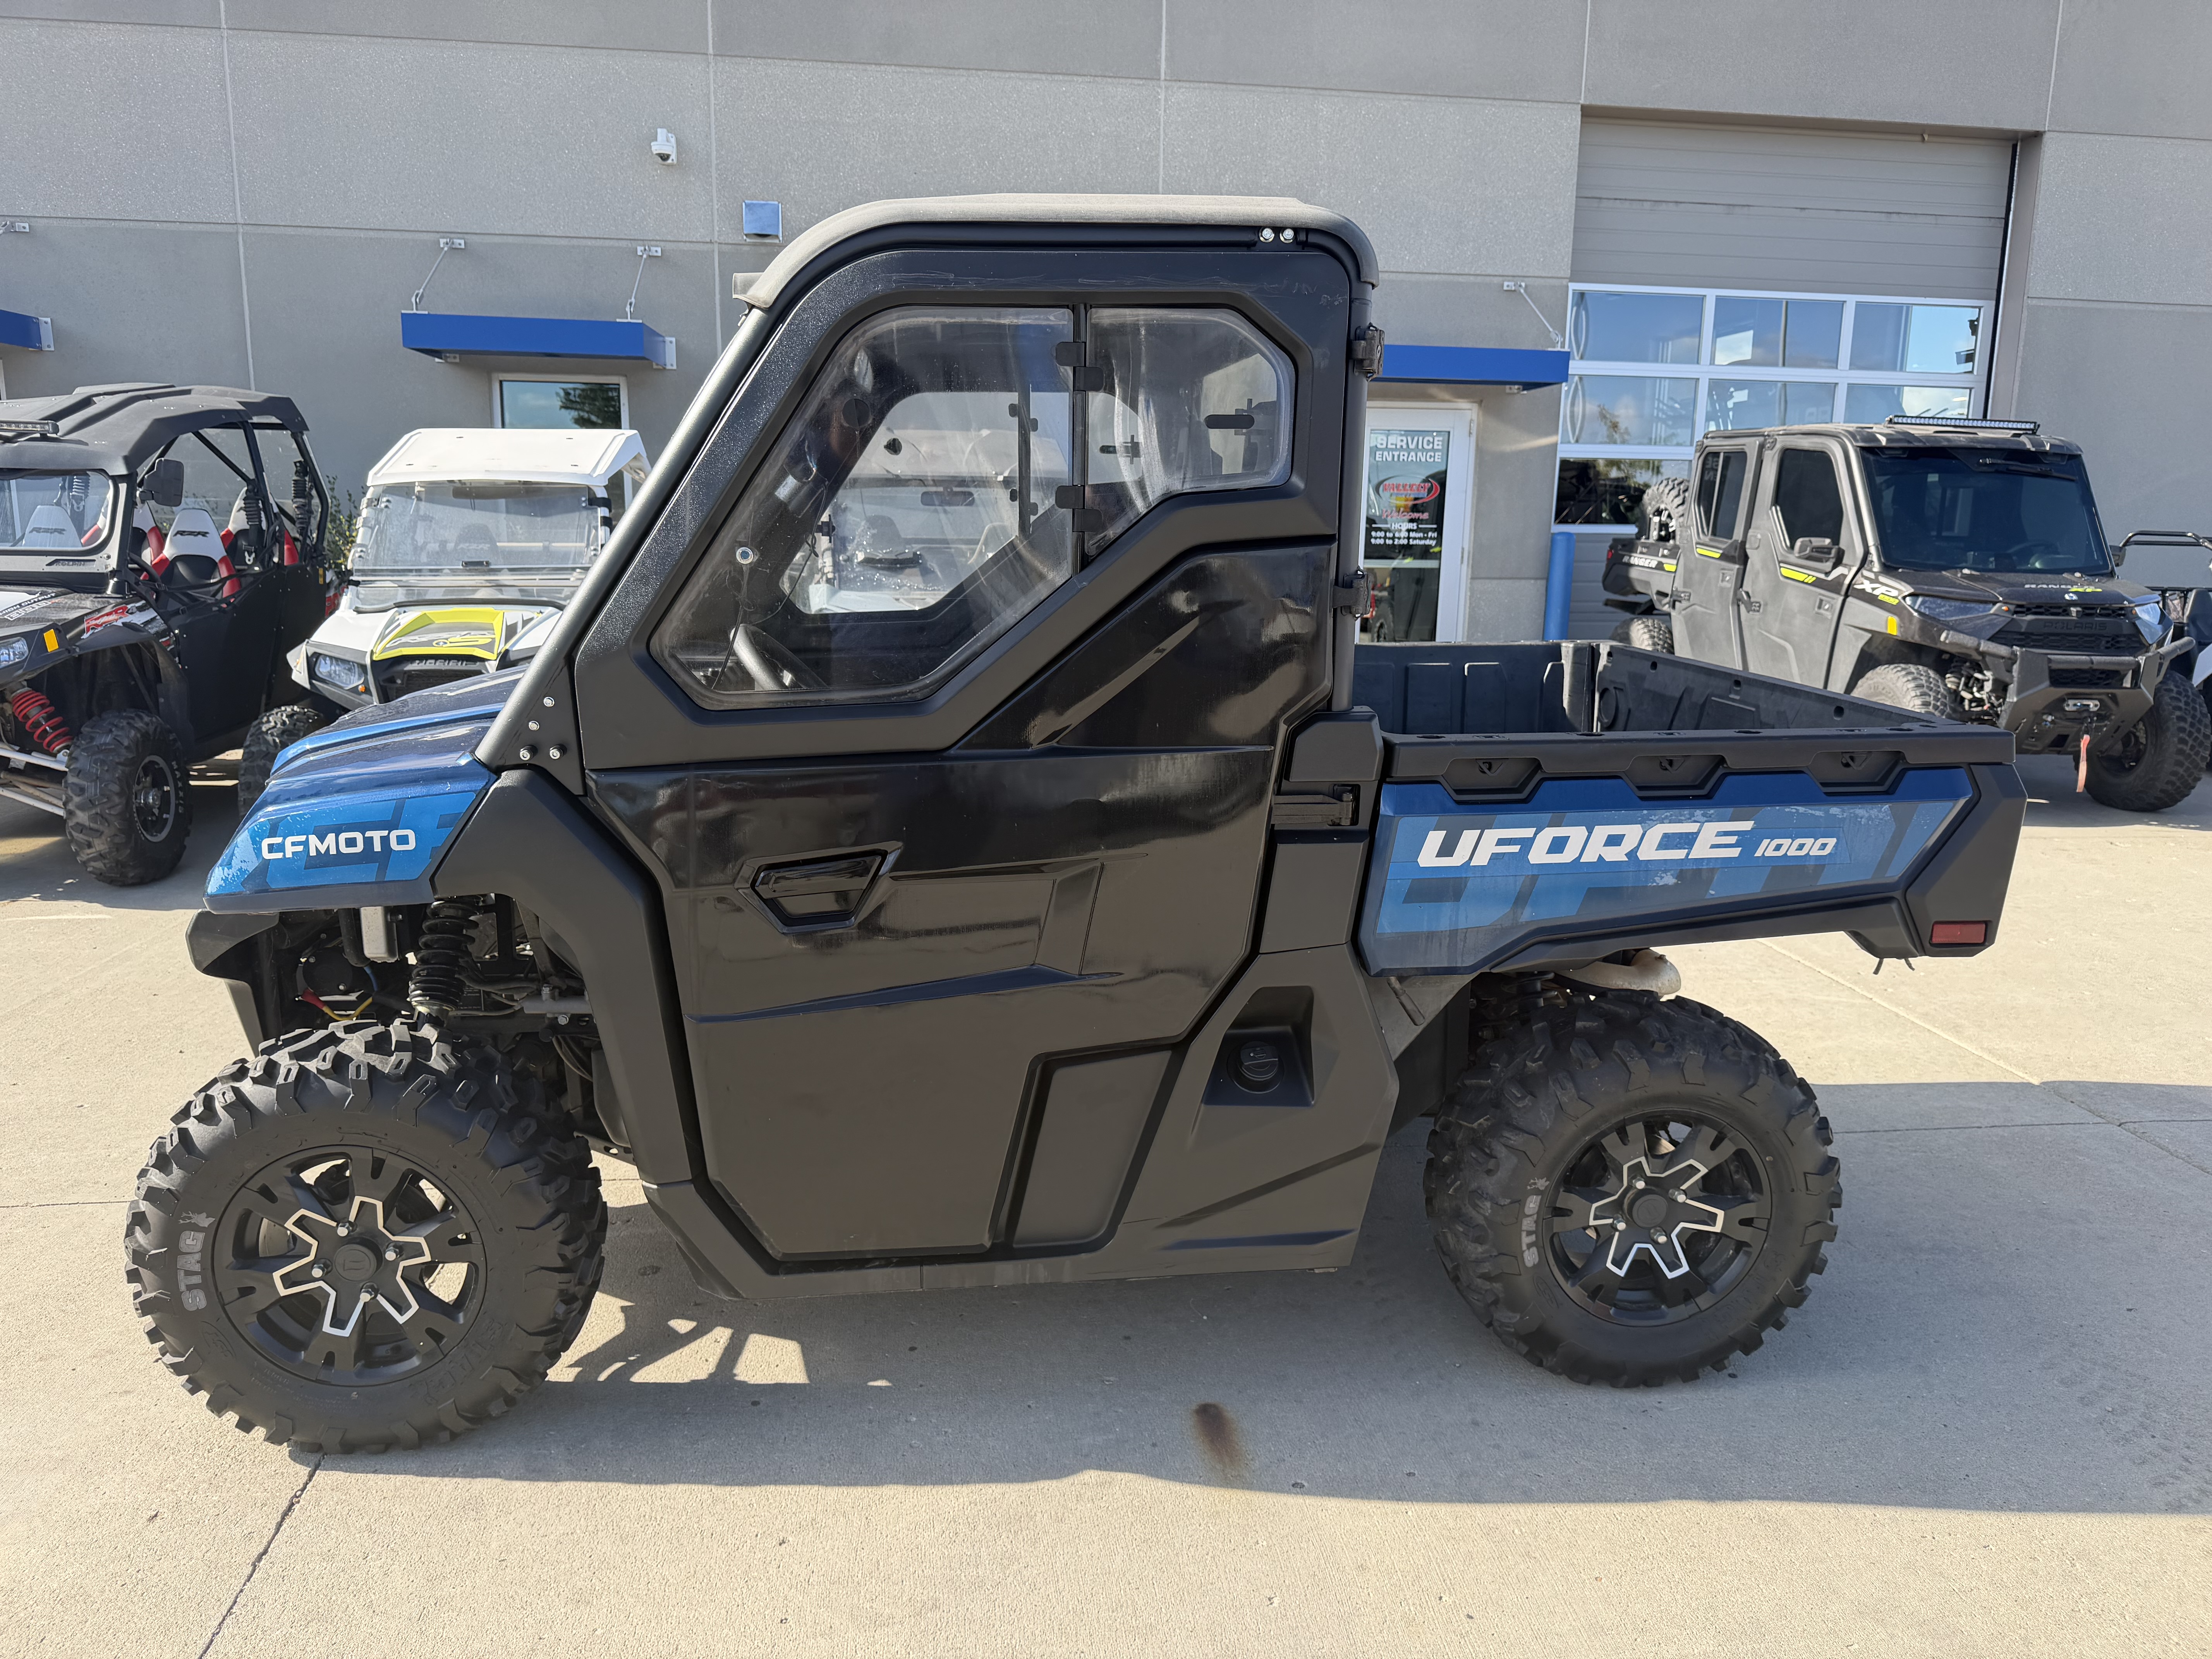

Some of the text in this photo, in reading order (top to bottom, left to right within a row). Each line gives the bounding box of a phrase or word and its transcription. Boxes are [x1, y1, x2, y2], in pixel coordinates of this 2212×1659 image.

[1376, 436, 1443, 449] SERVICE
[1376, 451, 1442, 462] ENTRANCE
[1381, 508, 1429, 519] Welcome
[1622, 555, 1658, 568] RANGER
[1853, 578, 1898, 597] XP
[2044, 622, 2107, 631] POLARIS
[172, 761, 184, 813] MAXXIS
[261, 829, 416, 860] CFMOTO
[1417, 821, 1837, 867] UFORCE 1000
[1521, 1195, 1542, 1267] STAG
[177, 1230, 206, 1311] STAG
